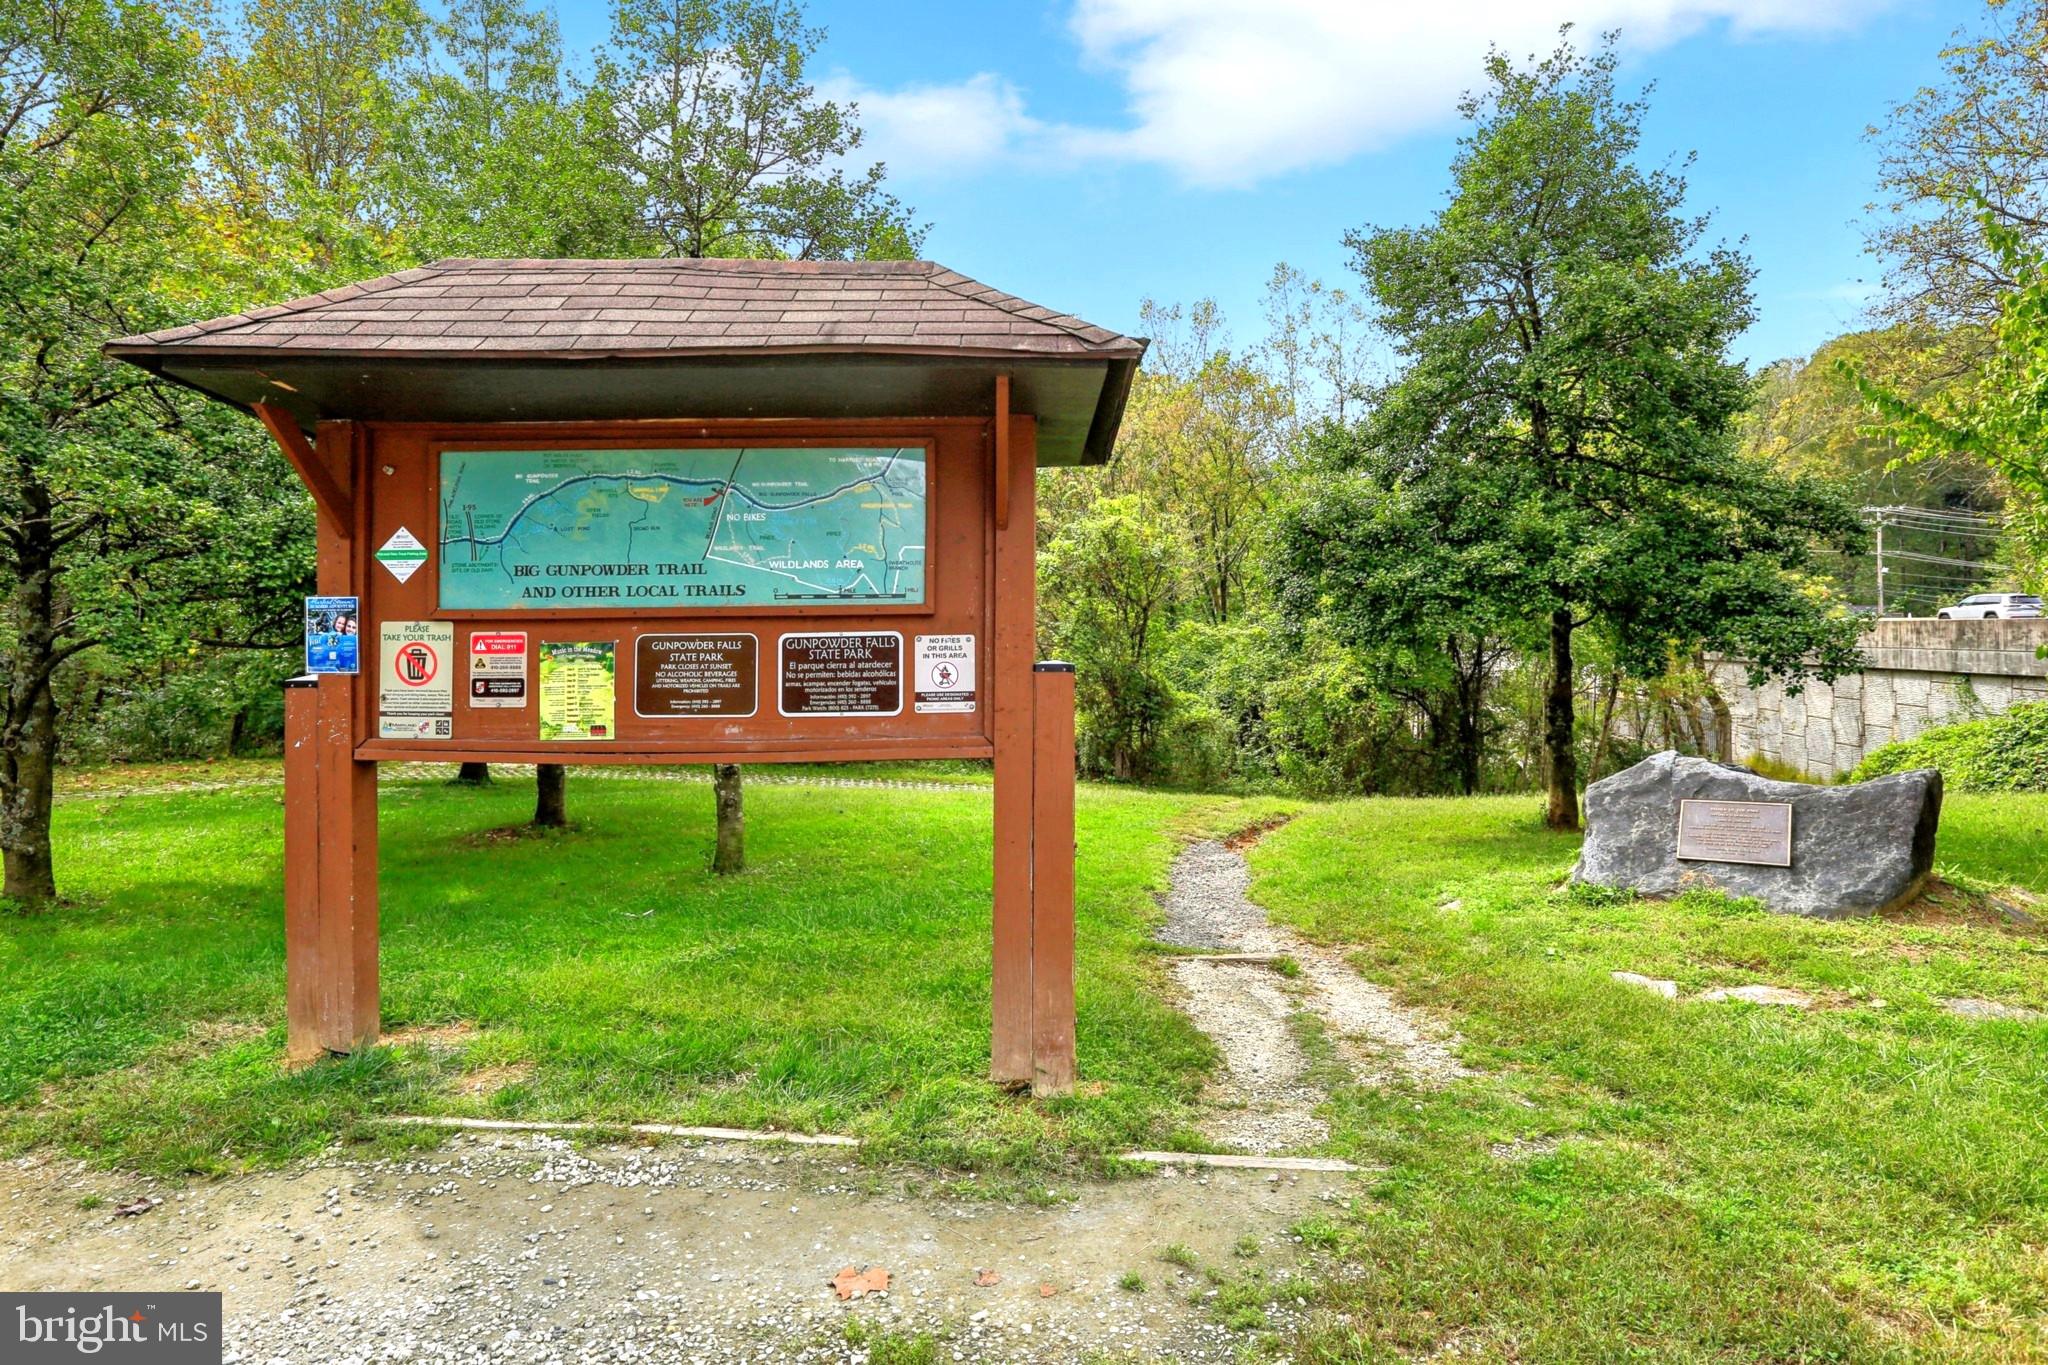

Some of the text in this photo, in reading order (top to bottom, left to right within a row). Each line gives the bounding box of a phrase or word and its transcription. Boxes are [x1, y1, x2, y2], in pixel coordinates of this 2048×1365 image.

[744, 513, 766, 521] BIKES
[769, 559, 864, 569] WILDLANDS AREA
[514, 563, 707, 577] BIG GUNPOWDER TRAIL
[522, 584, 746, 599] AND OTHER LOCAL TRAILS
[652, 641, 742, 650] GUNPOWDER FALLS
[786, 638, 896, 649] GUNPOWDER FALLS
[670, 653, 724, 661] STATE PARK
[809, 649, 873, 660] STATE PARK
[798, 663, 825, 671] parque
[849, 661, 856, 669] al
[805, 672, 836, 680] permiten:
